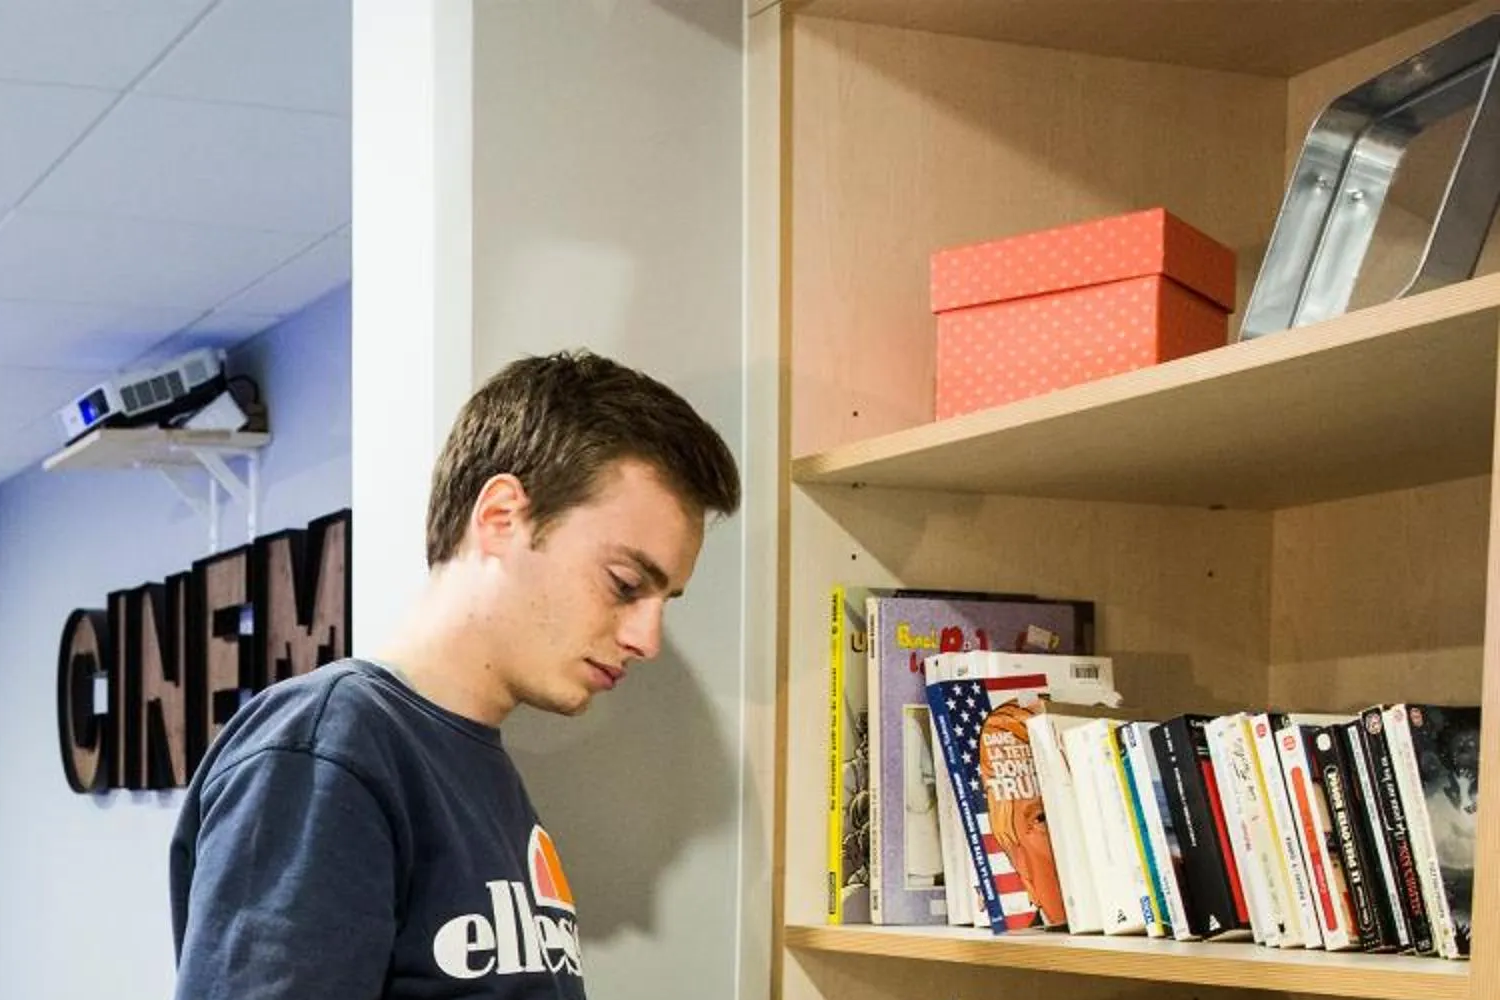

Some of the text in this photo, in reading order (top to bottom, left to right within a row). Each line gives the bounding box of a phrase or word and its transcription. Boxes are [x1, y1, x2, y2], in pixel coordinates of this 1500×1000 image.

[57, 508, 352, 795] CINEM
[992, 760, 1032, 777] DON
[987, 776, 1038, 801] TRU
